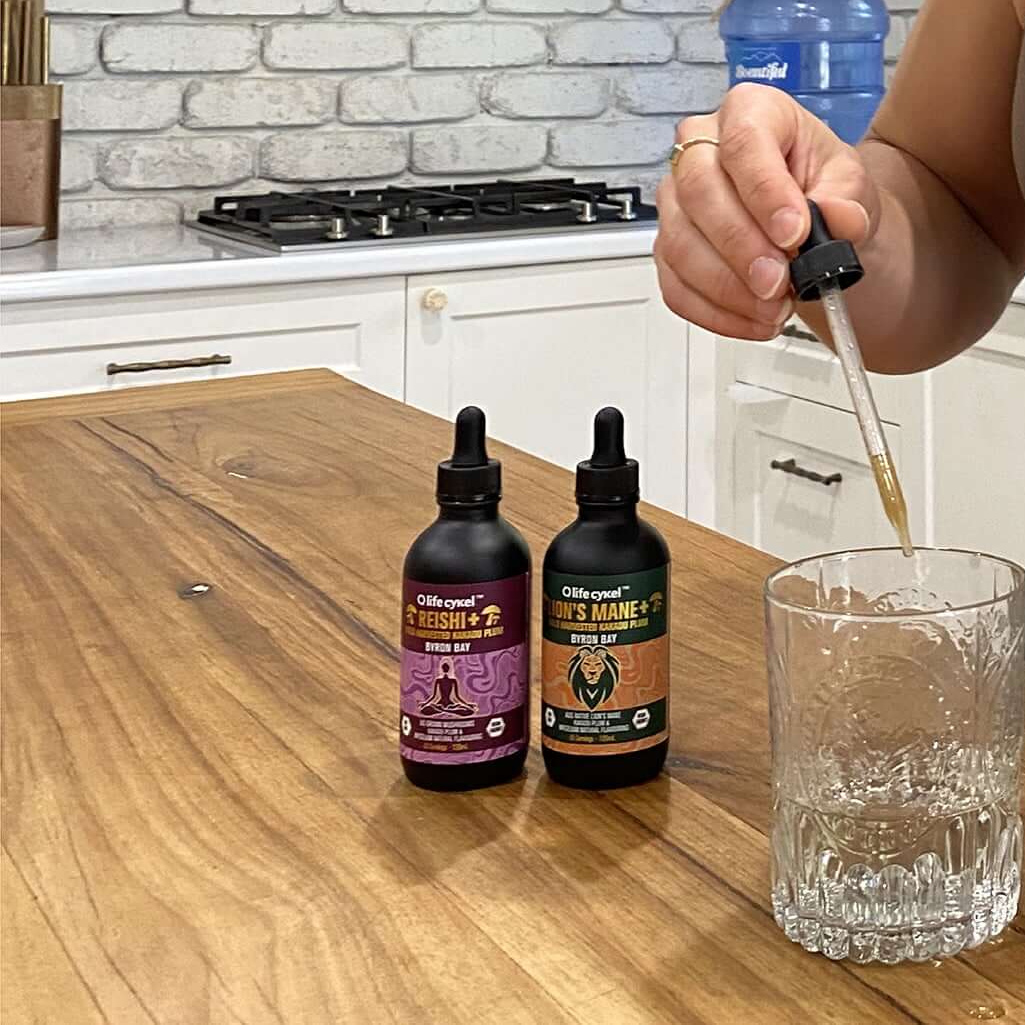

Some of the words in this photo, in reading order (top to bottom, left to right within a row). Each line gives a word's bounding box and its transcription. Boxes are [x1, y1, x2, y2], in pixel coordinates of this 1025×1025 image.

[571, 634, 598, 644] BYRON
[600, 634, 617, 644] BAY
[425, 641, 451, 652] BYRON
[454, 642, 471, 652] BAY
